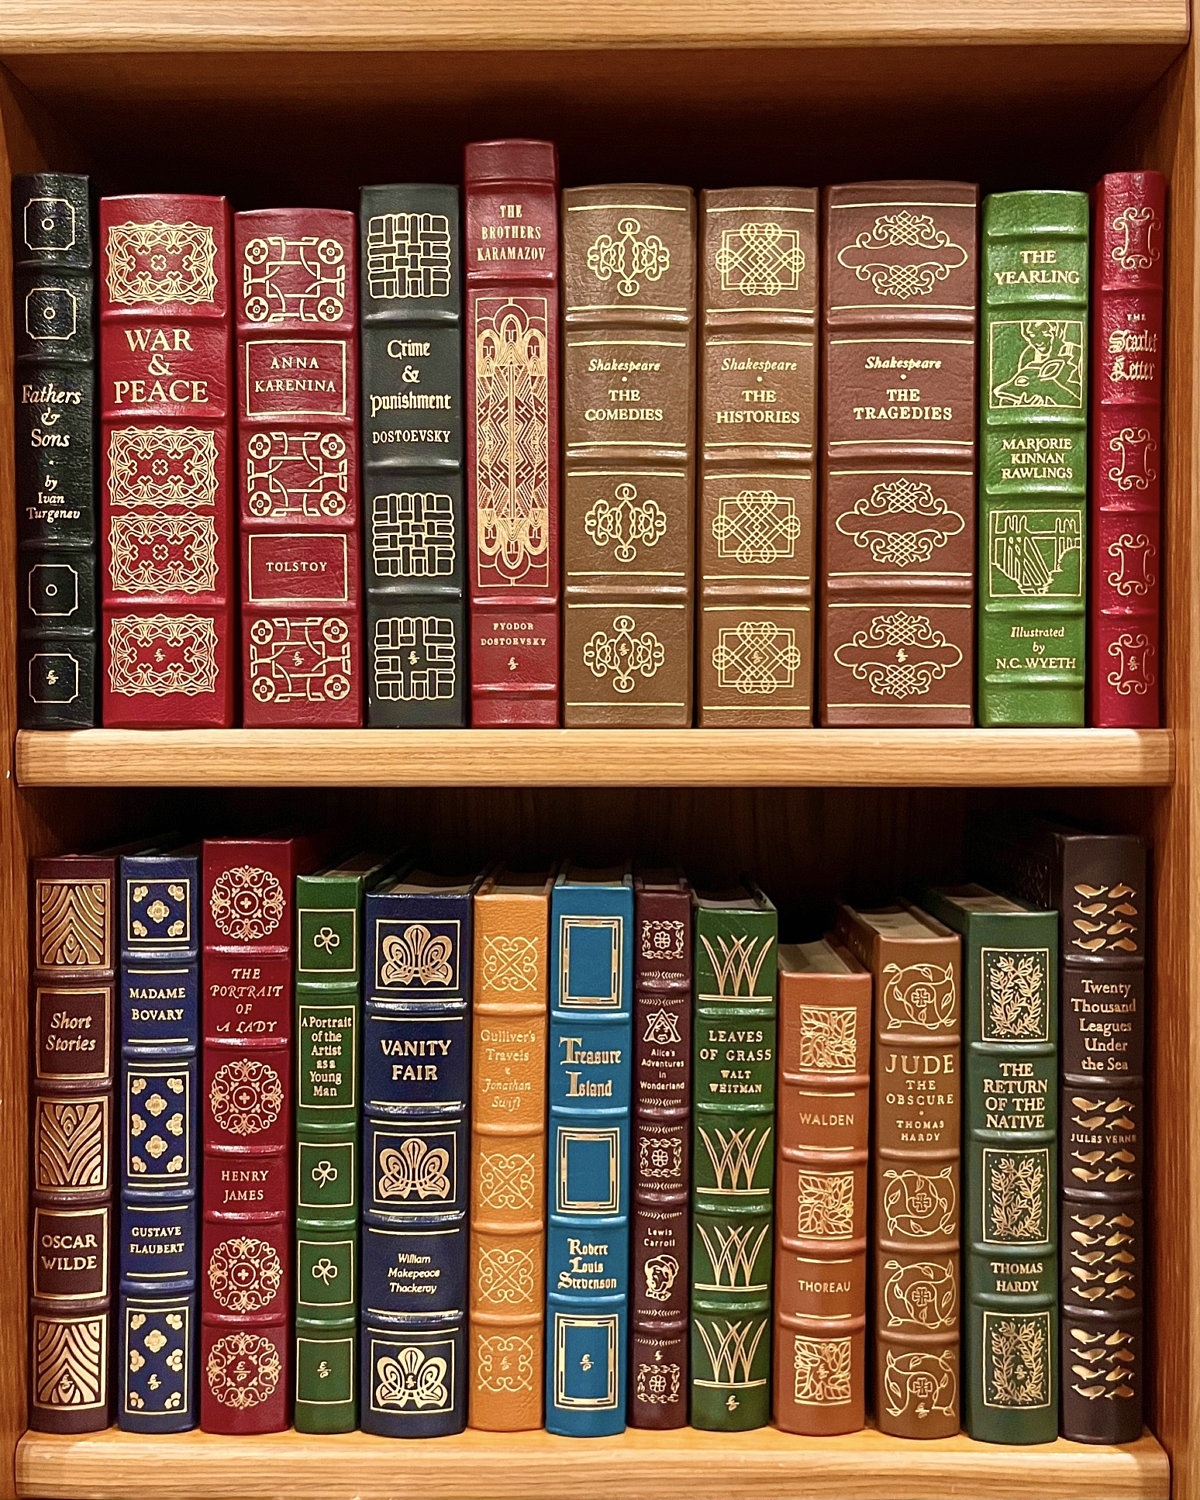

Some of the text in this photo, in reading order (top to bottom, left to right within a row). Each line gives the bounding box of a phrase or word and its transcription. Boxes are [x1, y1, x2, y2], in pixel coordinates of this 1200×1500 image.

[476, 246, 546, 262] KARAMAZOV
[993, 269, 1080, 286] YEARLING
[124, 328, 194, 352] WAR
[270, 356, 320, 370] ANNA
[113, 379, 209, 404] PEACE
[254, 378, 336, 393] KARENINA
[715, 410, 800, 424] HISTORIES
[852, 405, 953, 421] TRAGEDIES
[31, 428, 71, 448] Sons
[1010, 452, 1067, 465] KINNAN
[1000, 466, 1073, 480] RAWLINGS
[265, 561, 328, 573] TOLSTOY
[1010, 626, 1065, 638] Illustrated
[129, 987, 186, 999] MADAME
[50, 1011, 93, 1030] Short
[131, 1008, 184, 1021] BOVARY
[45, 1034, 97, 1052] Stories
[708, 1029, 763, 1043] LEAVES
[380, 1039, 452, 1057] VANITY
[1084, 1037, 1128, 1052] Under
[885, 1053, 955, 1075] JUDE
[391, 1064, 438, 1081] FAIR
[983, 1078, 1048, 1095] RETURN
[885, 1092, 954, 1106] OBSCURE
[799, 1112, 854, 1126] WALDEN
[986, 1113, 1045, 1129] NATIVE
[221, 1170, 270, 1182] HENRY
[222, 1189, 264, 1204] JAMES
[41, 1233, 98, 1249] OSCAR
[129, 1242, 185, 1254] FLAUBERT
[41, 1255, 98, 1271] WILDE
[797, 1279, 851, 1293] THOREAU
[995, 1279, 1039, 1293] HARDY
